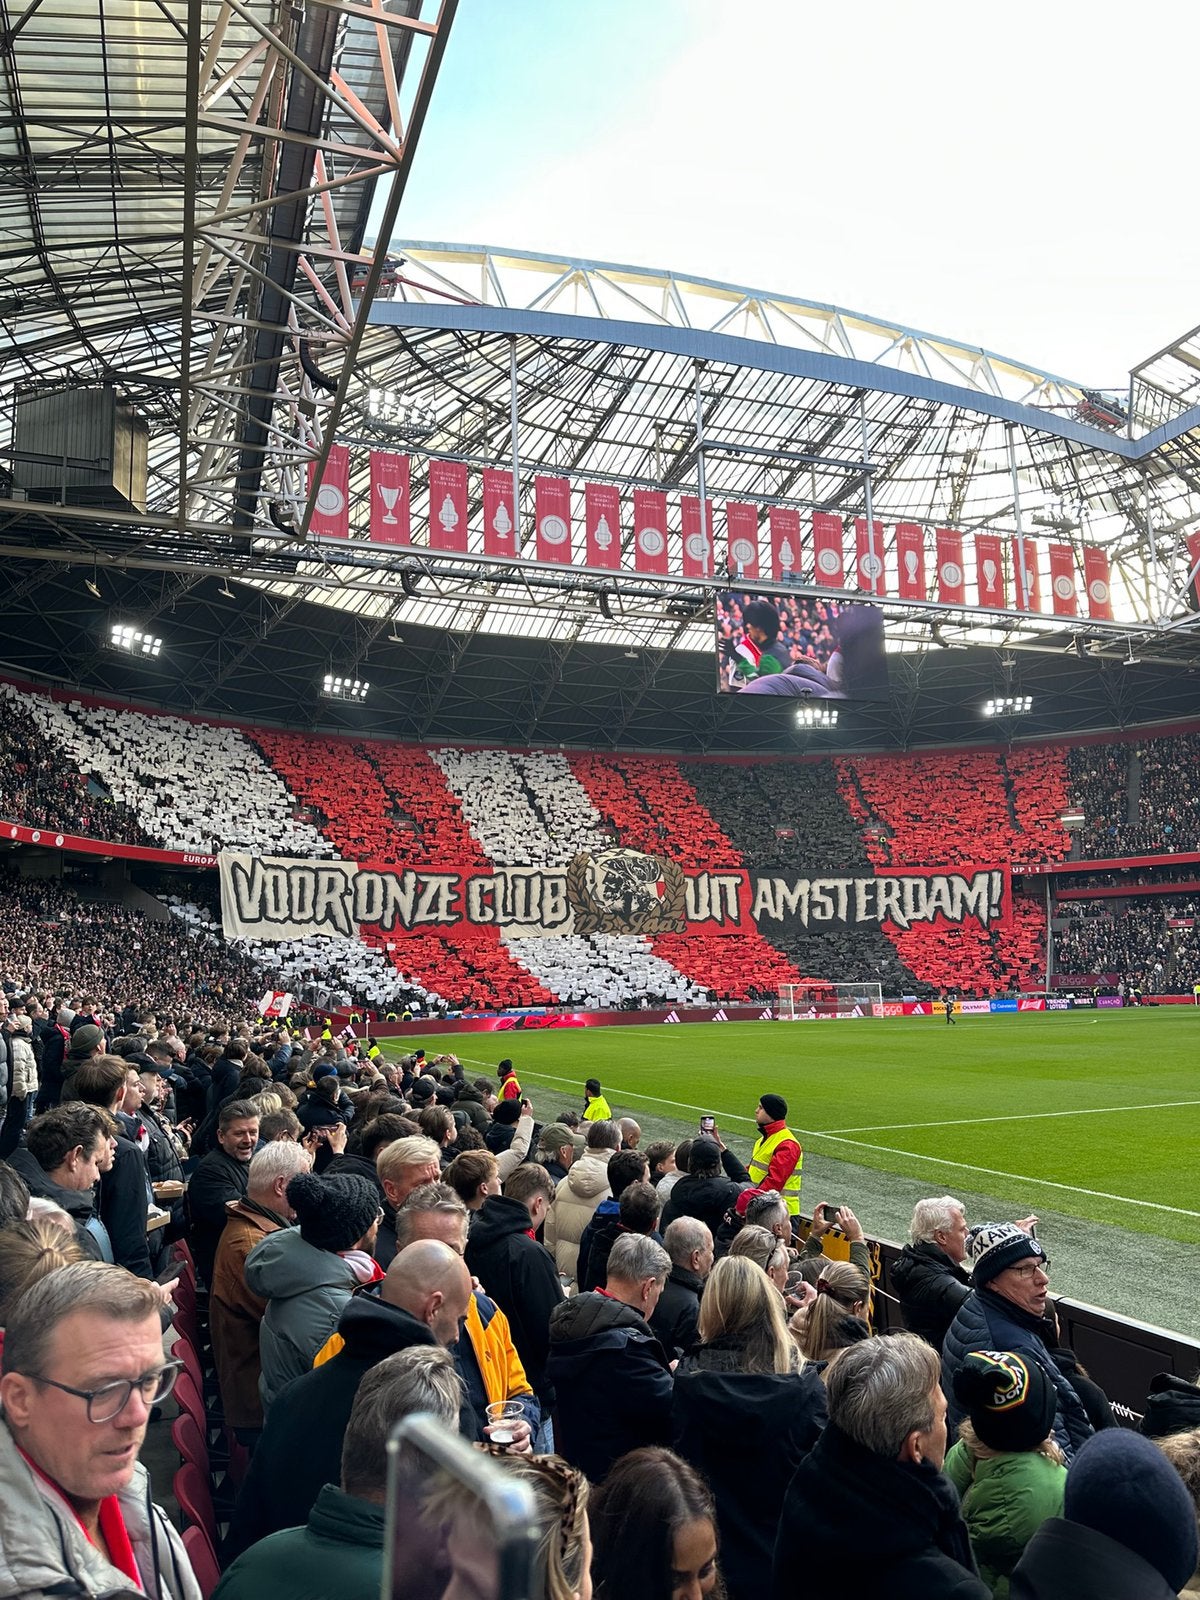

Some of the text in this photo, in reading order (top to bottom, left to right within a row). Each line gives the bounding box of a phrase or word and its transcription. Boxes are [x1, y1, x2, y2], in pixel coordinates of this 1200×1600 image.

[231, 857, 1006, 937] VOOR ONZE CLUB UIT AMSTERDAM!
[574, 911, 688, 936] 125 Jaar
